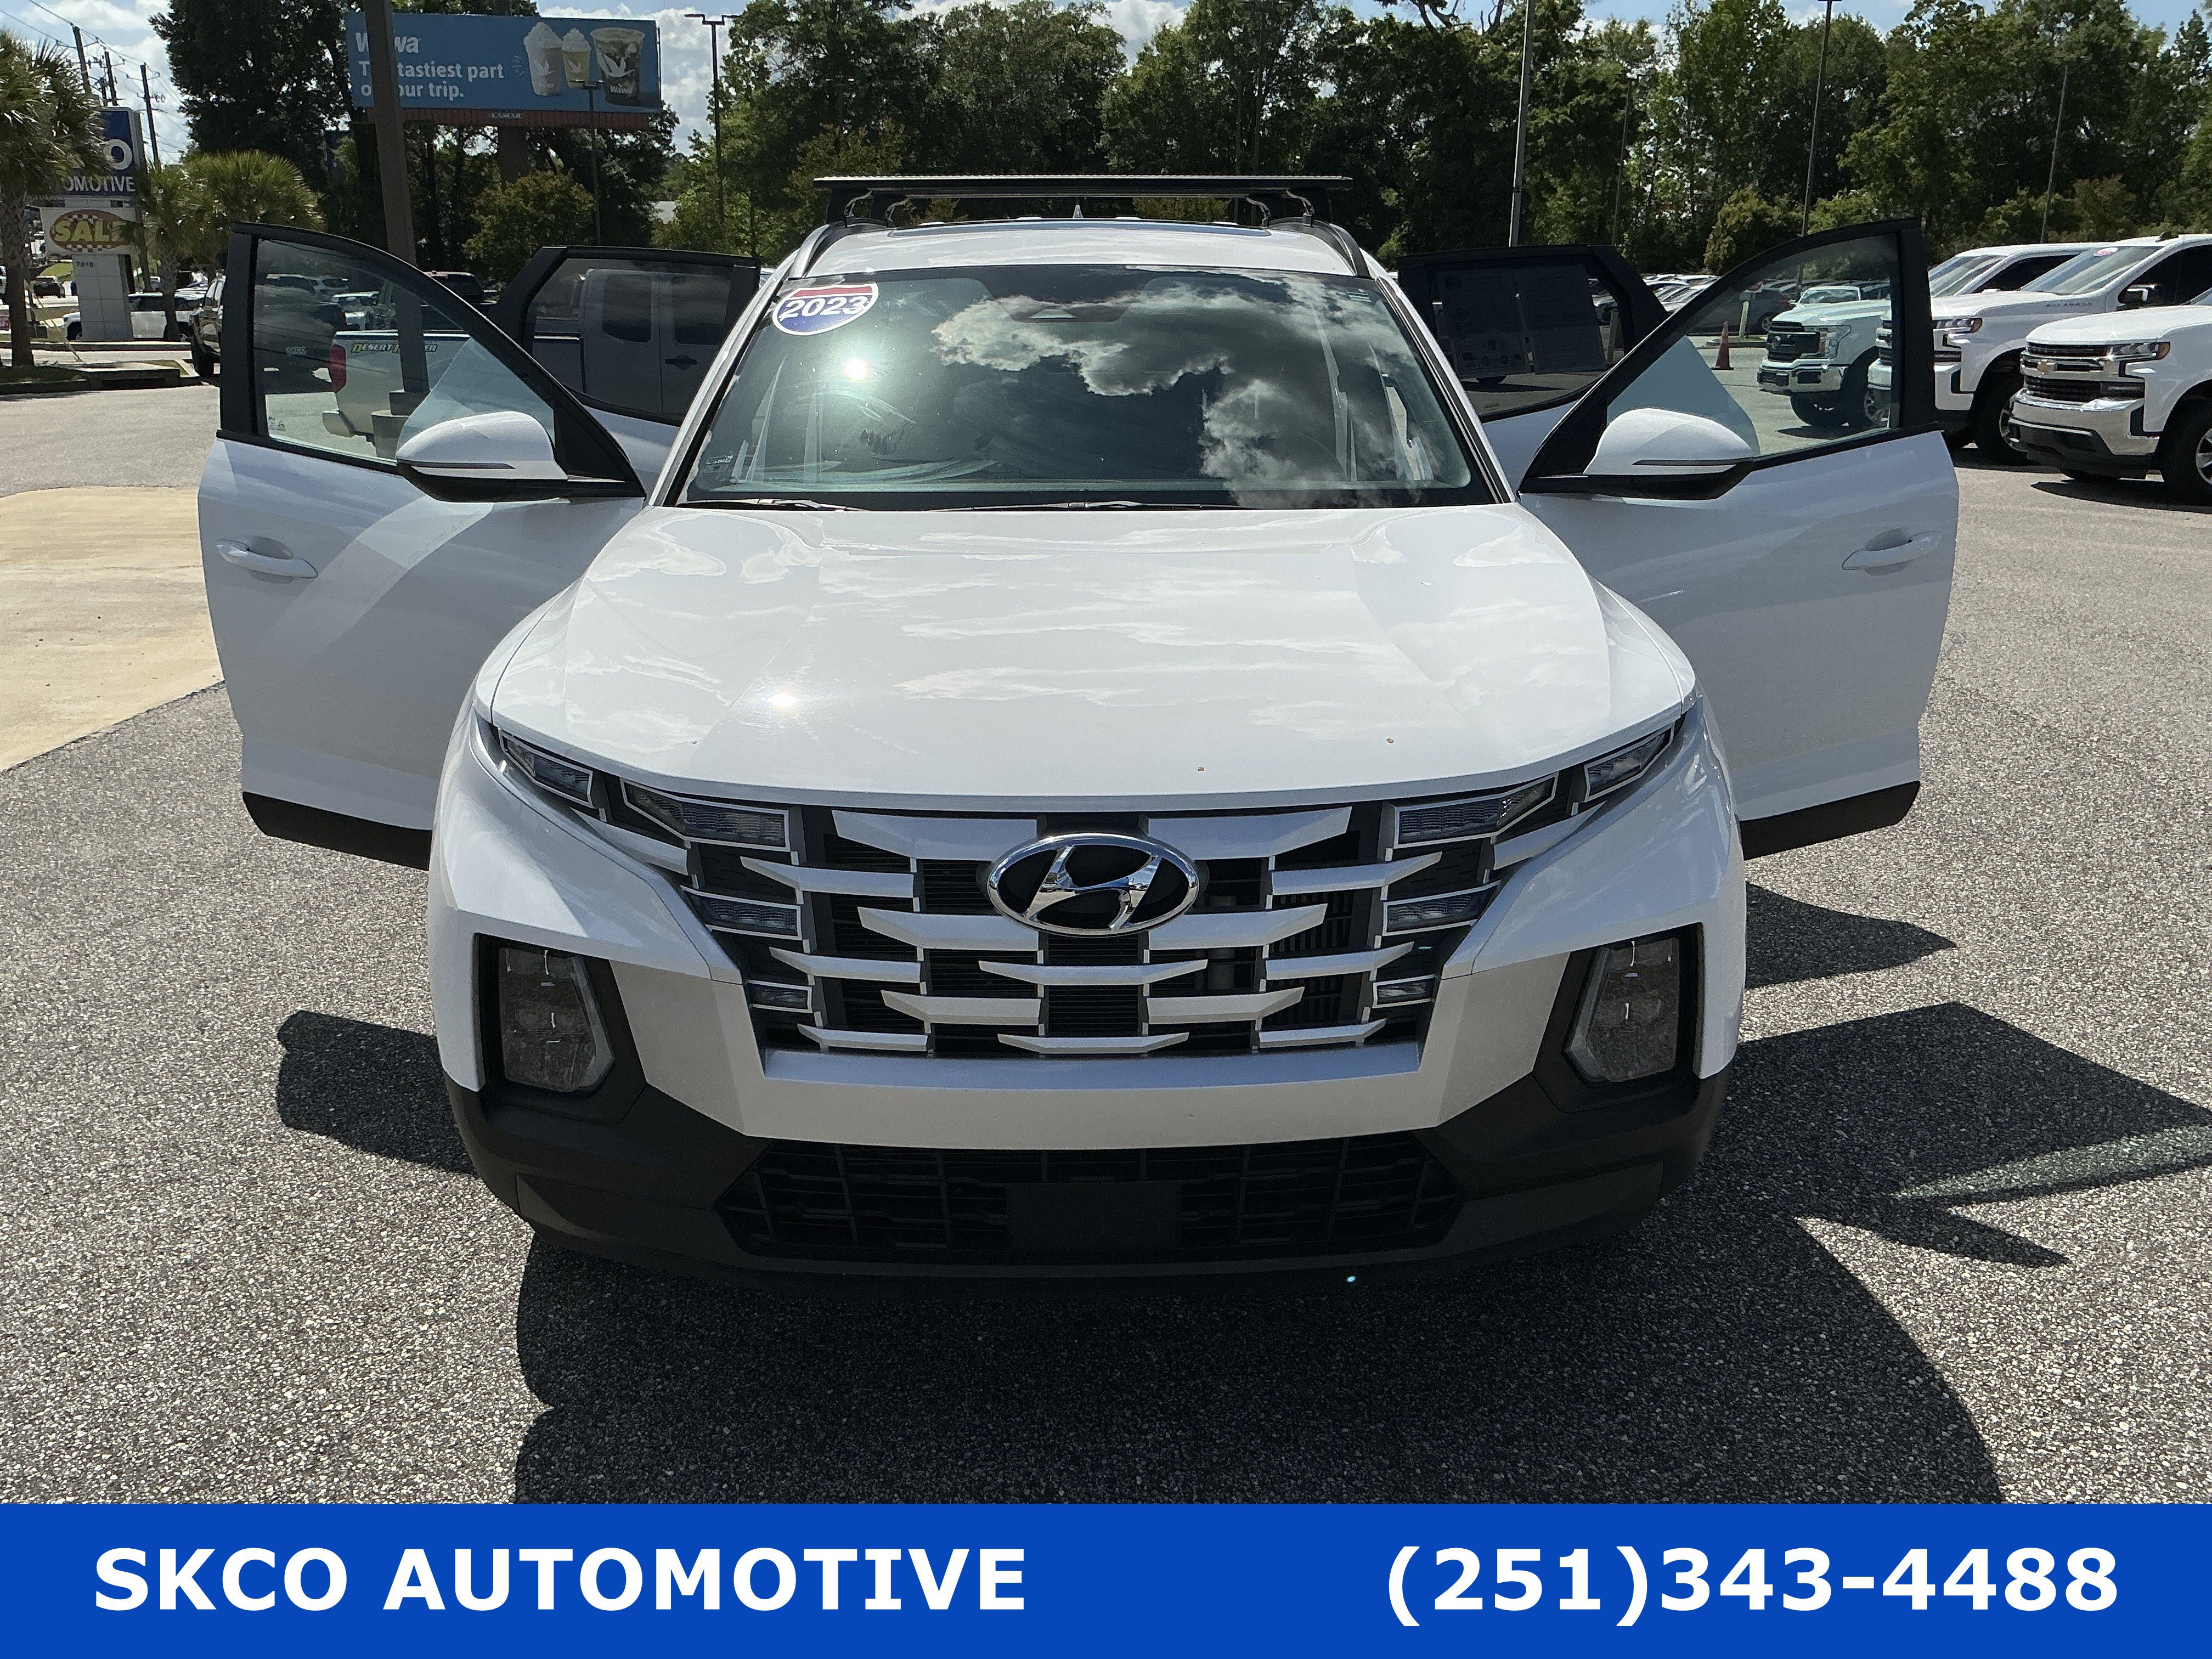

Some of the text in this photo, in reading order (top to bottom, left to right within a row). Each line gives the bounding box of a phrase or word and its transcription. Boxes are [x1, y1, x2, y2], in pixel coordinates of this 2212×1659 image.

[355, 32, 419, 54] Wwa
[397, 60, 504, 82] tastiest part
[360, 84, 372, 97] o
[428, 81, 465, 102] trip.
[63, 174, 136, 192] OMOTIVE
[778, 296, 870, 323] 2023
[351, 343, 393, 353] DESERT
